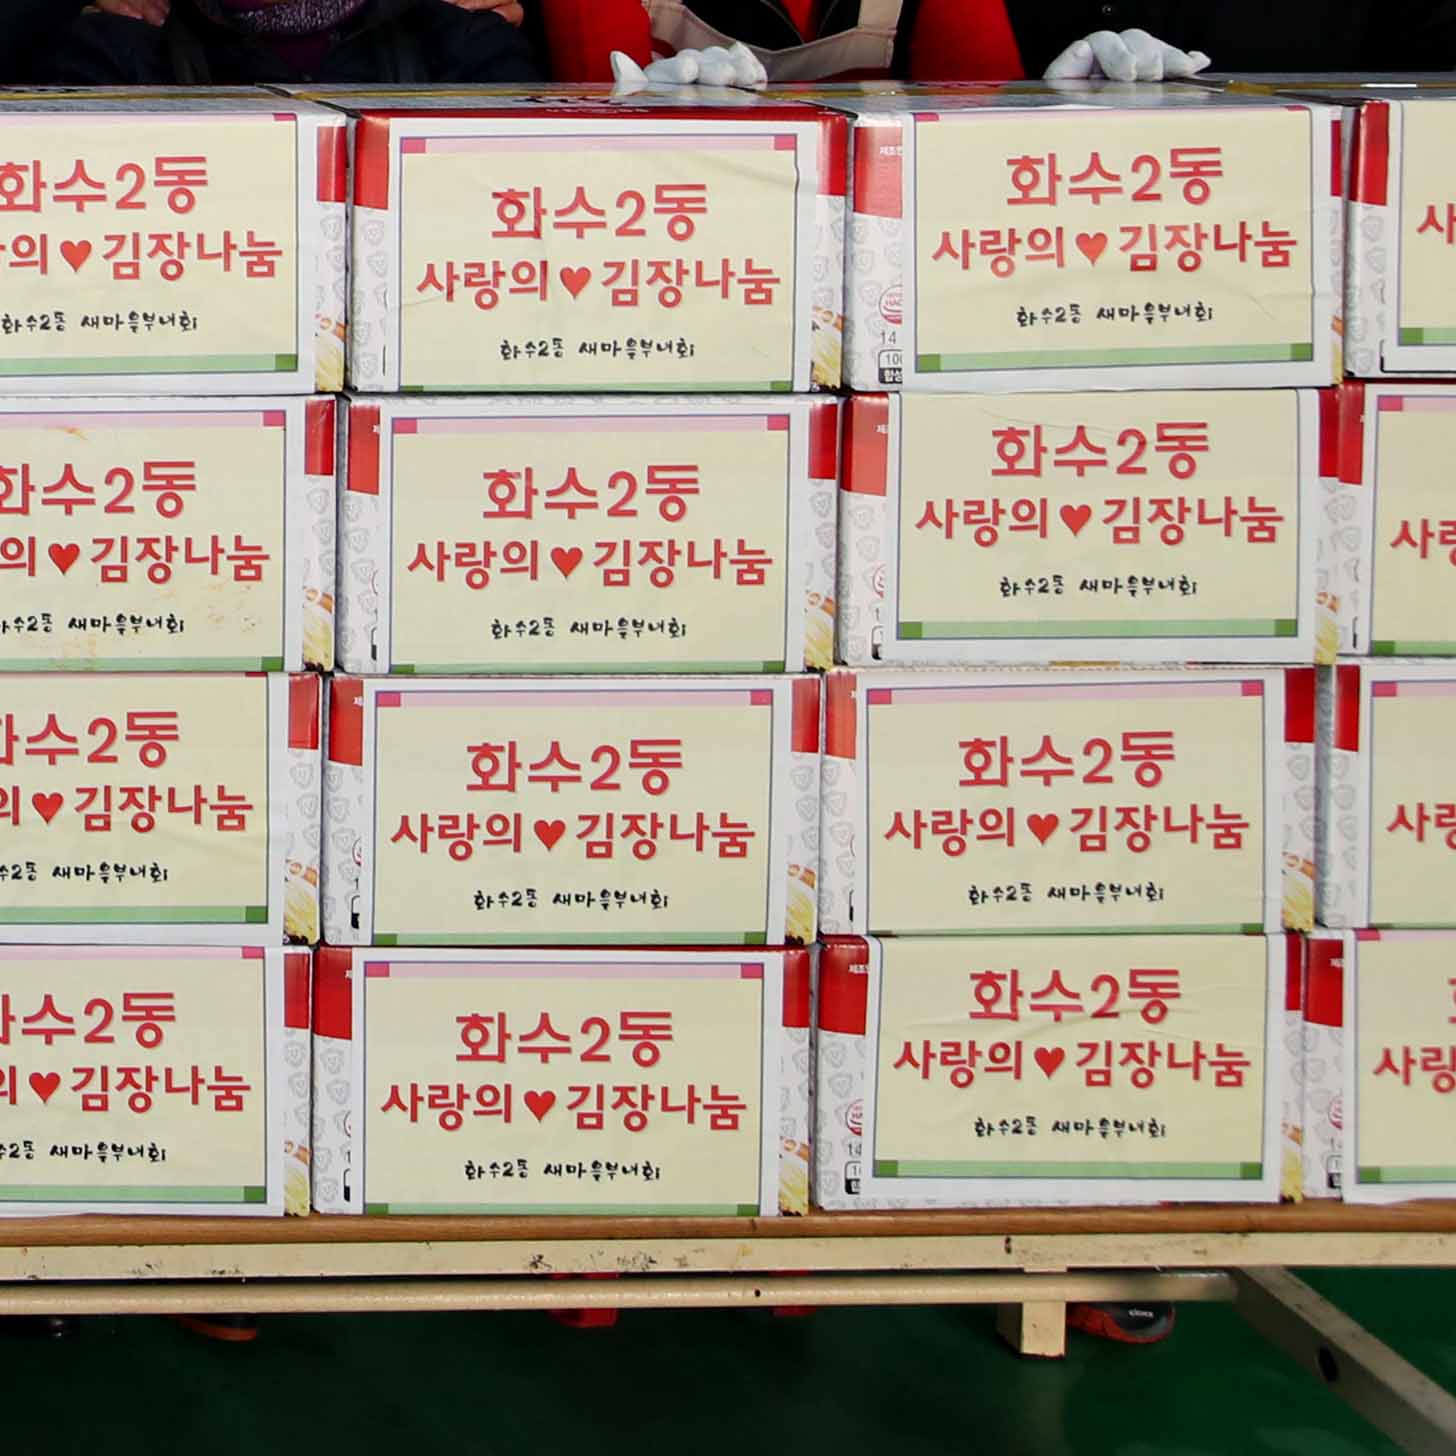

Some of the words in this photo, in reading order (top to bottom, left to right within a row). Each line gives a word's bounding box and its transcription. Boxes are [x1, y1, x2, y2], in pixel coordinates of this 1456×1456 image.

[1006, 145, 1224, 207] 화수2동
[490, 182, 709, 242] 화수2동
[499, 336, 564, 362] 화수2동
[990, 420, 1211, 481] 화수2동
[482, 463, 701, 524] 화수2동
[464, 737, 684, 797] 화수2동
[958, 729, 1176, 790] 화수2동
[472, 886, 538, 912] 화수2동
[968, 967, 1182, 1026] 화수2동
[455, 1009, 674, 1070] 화수2동
[973, 1114, 1038, 1139] 화수2동
